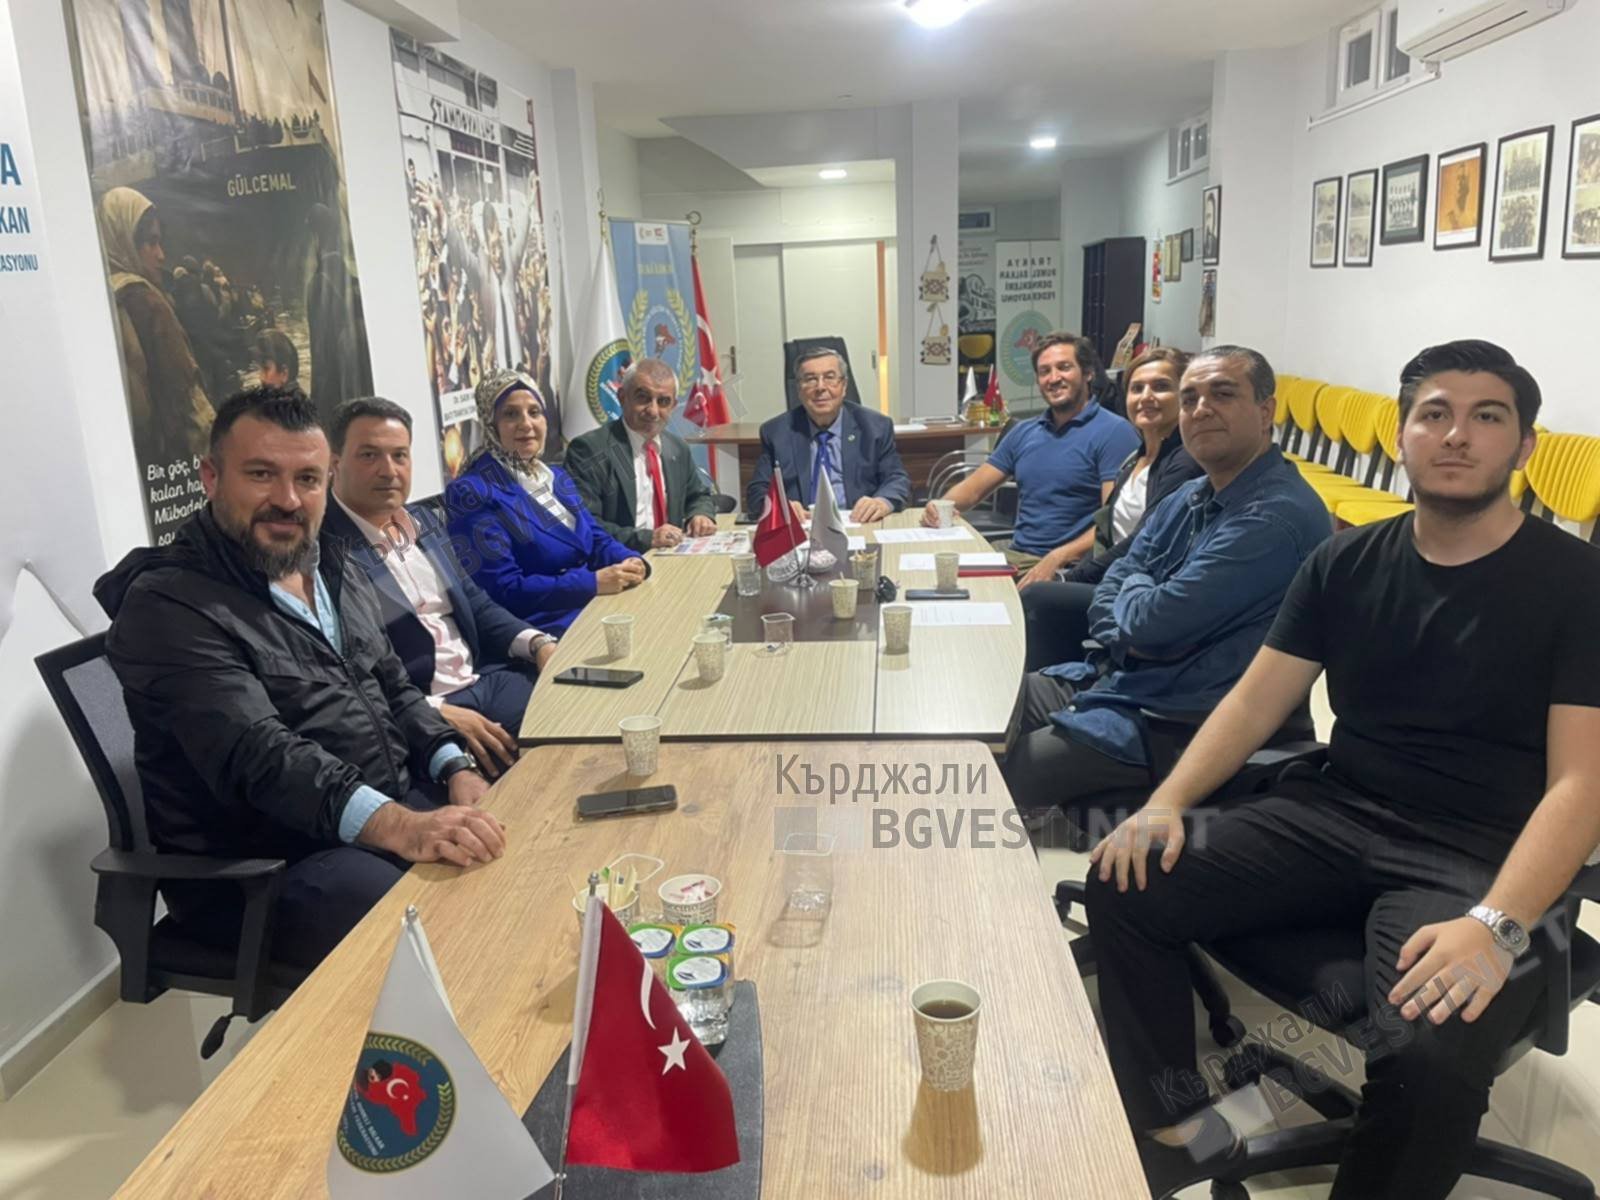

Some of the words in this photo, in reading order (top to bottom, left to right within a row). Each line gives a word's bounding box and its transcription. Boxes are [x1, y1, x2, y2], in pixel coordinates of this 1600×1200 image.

[227, 173, 297, 197] GÜLCEMAL
[147, 463, 165, 480] Bir
[150, 483, 184, 503] kalan
